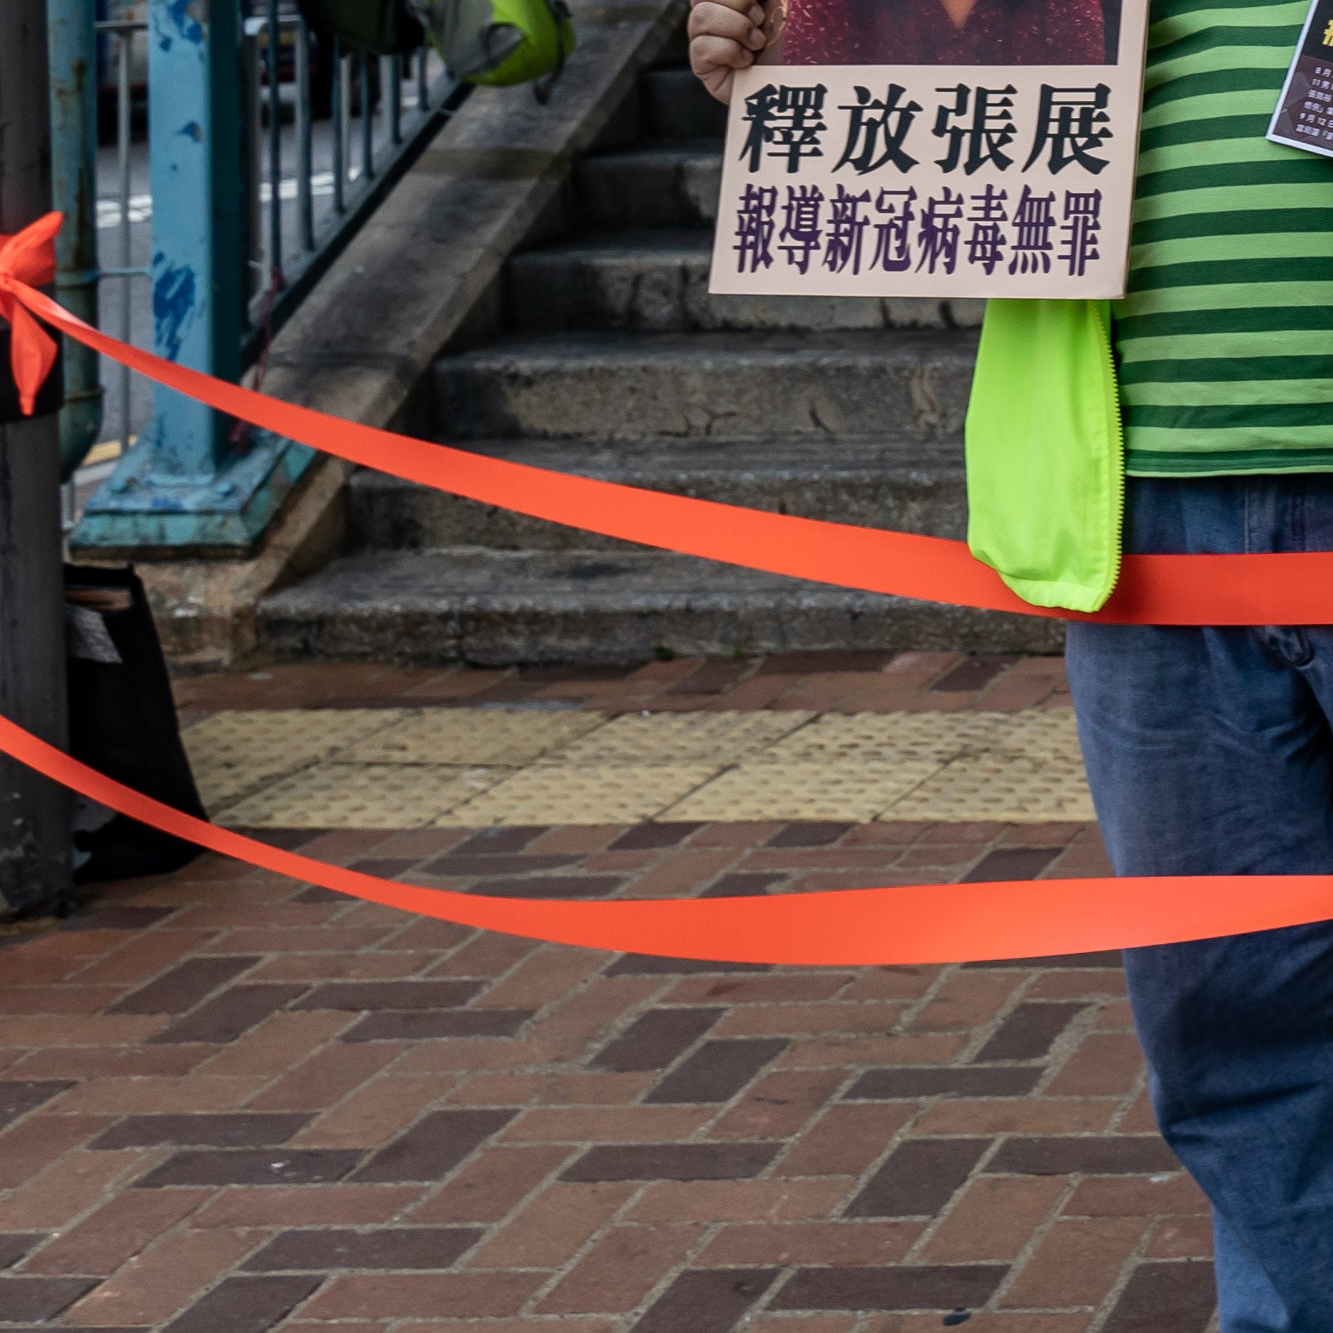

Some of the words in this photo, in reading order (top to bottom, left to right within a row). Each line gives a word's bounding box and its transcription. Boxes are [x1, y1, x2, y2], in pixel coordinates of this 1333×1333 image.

[738, 83, 1114, 175] 釋放張展
[732, 183, 1102, 276] 報導新冠病毒無罪
